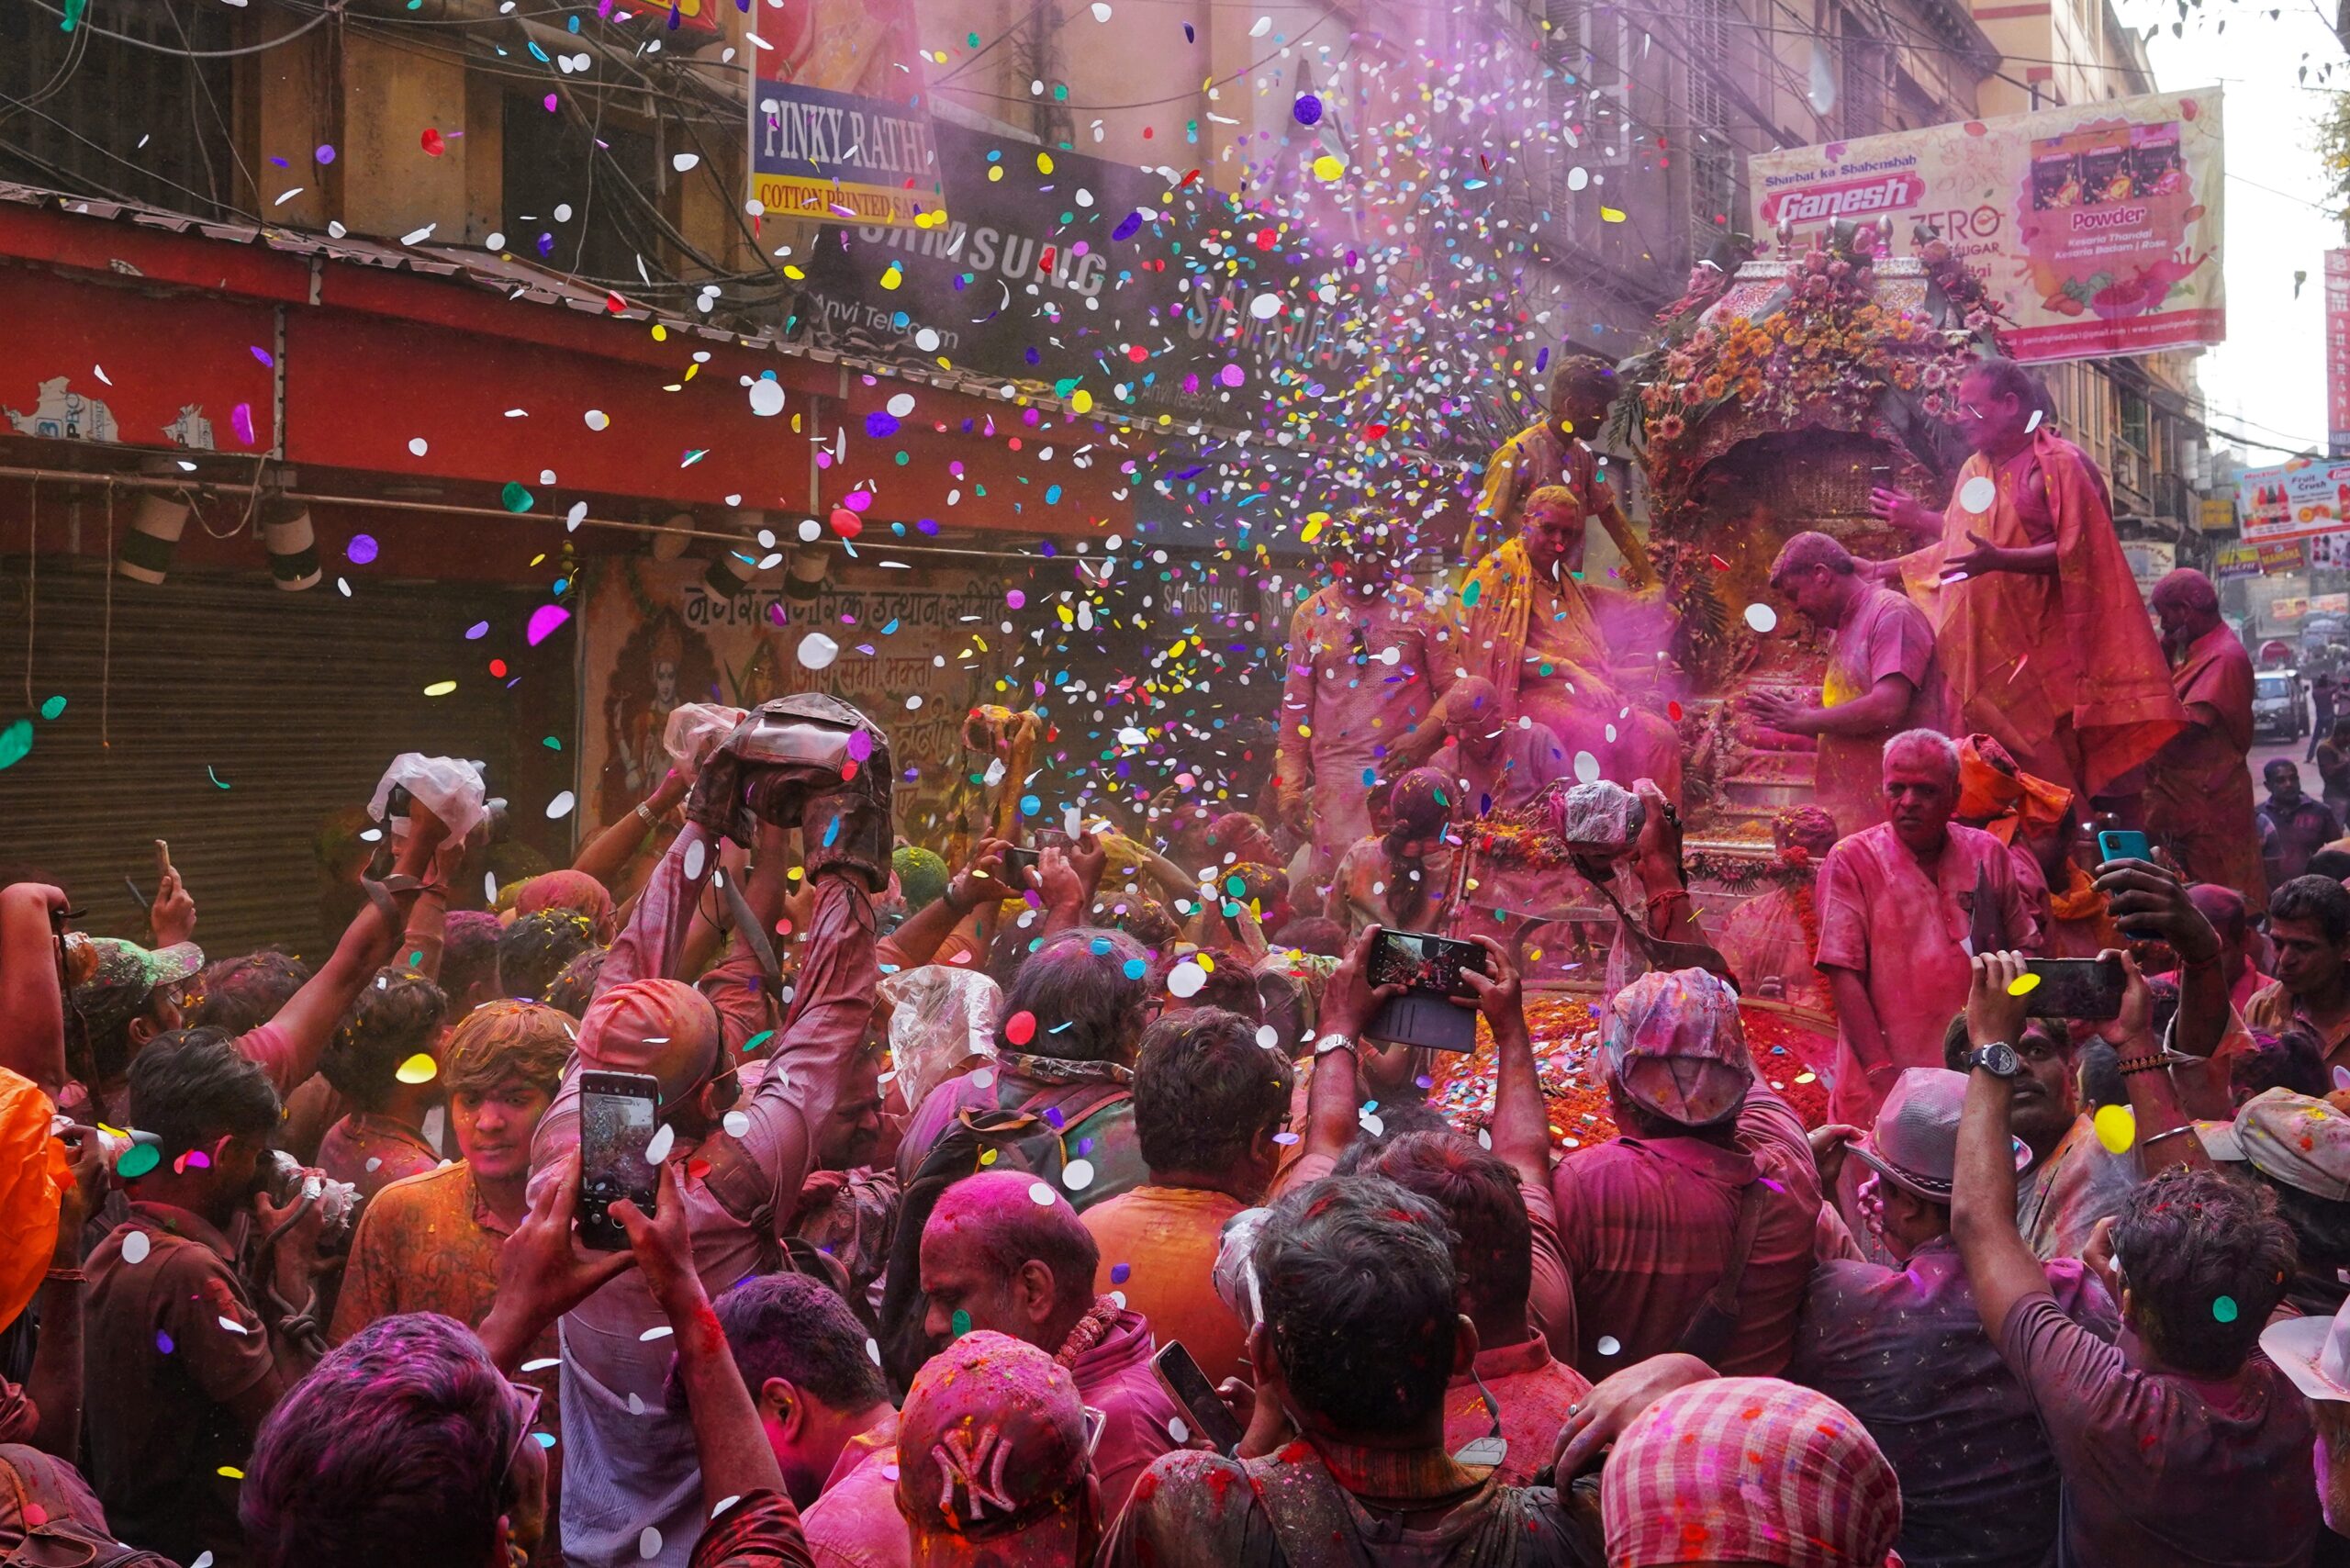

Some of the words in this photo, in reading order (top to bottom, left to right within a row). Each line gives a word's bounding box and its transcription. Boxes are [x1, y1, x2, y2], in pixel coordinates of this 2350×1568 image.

[763, 97, 844, 165] PINKY
[1765, 171, 1816, 188] Sharbat
[1820, 166, 1836, 180] ka
[1840, 153, 1917, 175] Shahenshah
[760, 183, 823, 212] COTTON
[825, 189, 891, 218] PRINTED
[1775, 178, 1909, 223] Ganesh
[2072, 206, 2145, 230] Powder
[2054, 247, 2093, 260] Kesaria
[2142, 240, 2167, 251] Rose
[2068, 234, 2107, 247] Kesaria
[2109, 229, 2153, 242] Thandai
[865, 307, 958, 350] Telcm
[2291, 474, 2316, 484] Fruit
[2298, 480, 2327, 491] Crush
[1164, 584, 1239, 614] SAMSUNG
